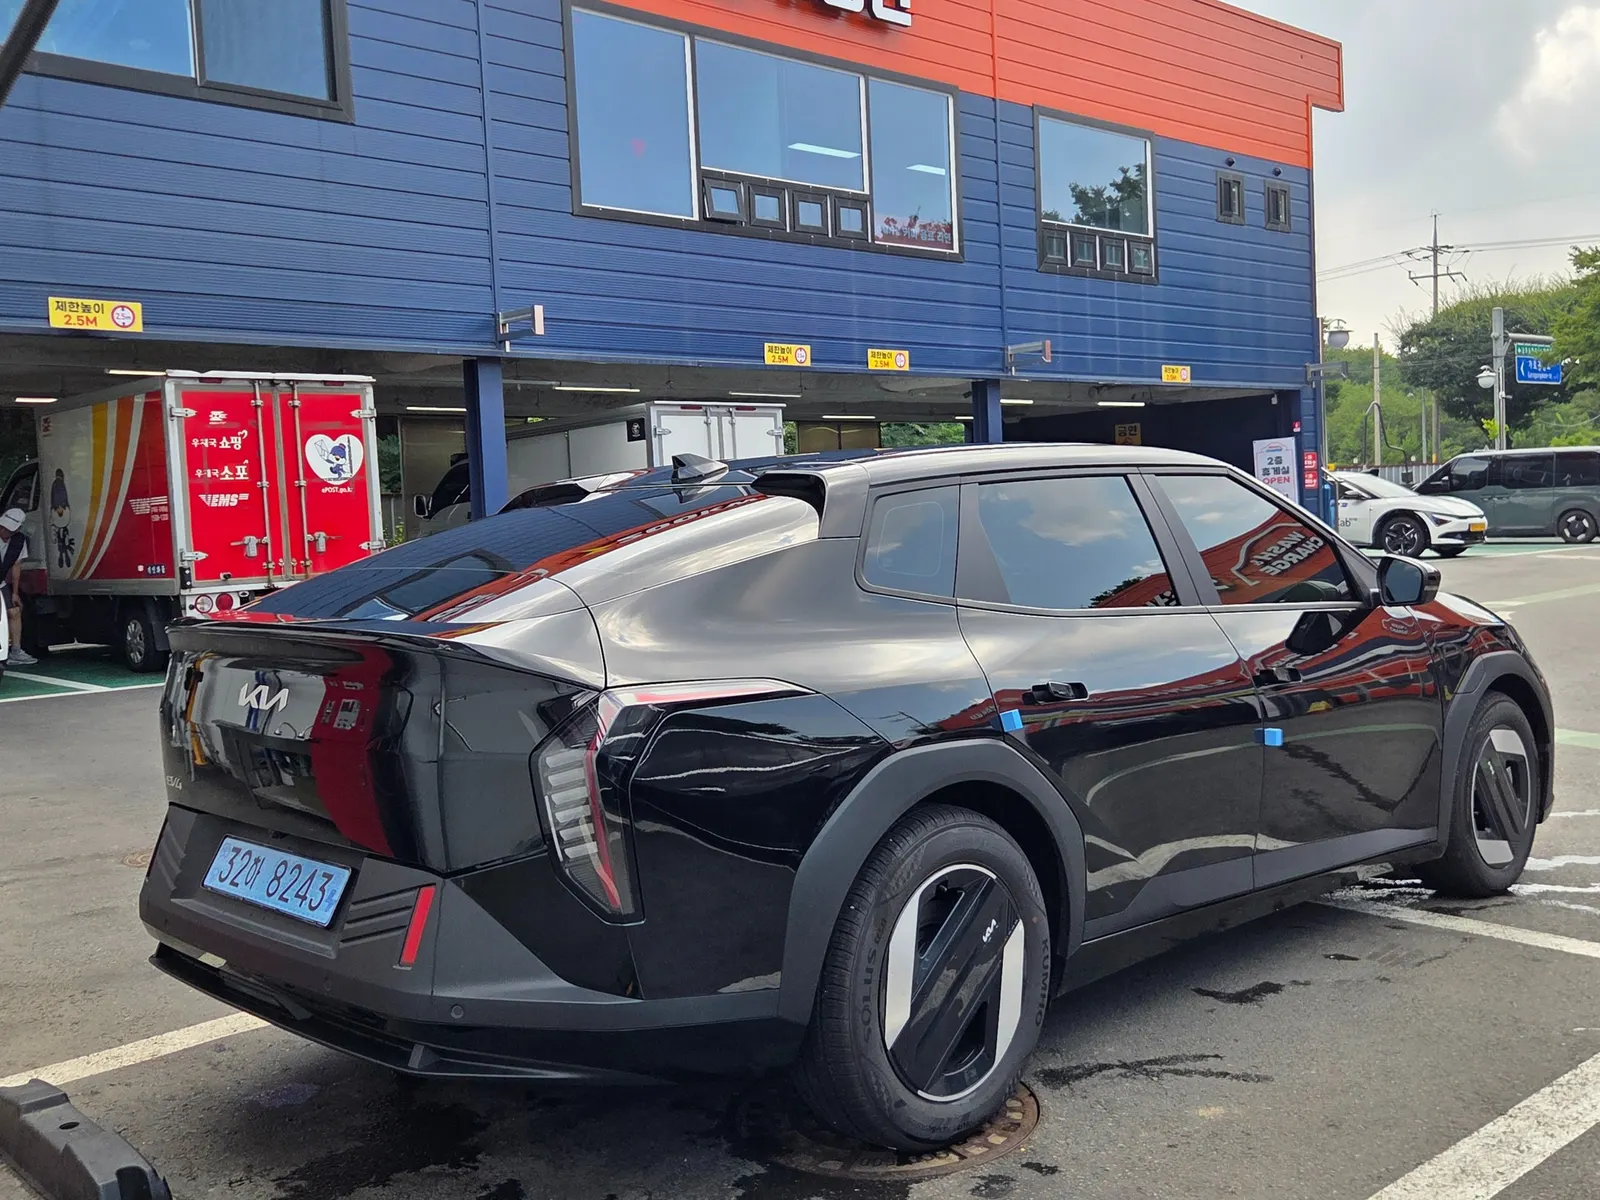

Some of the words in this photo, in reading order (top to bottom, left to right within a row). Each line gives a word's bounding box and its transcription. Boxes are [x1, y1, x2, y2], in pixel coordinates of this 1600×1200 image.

[55, 300, 104, 314] 제한높이
[63, 314, 98, 327] 2.5M
[771, 354, 789, 364] 2.5M
[874, 359, 890, 368] 2.5M
[219, 430, 248, 450] 쇼핑
[220, 465, 249, 481] 소포
[1261, 465, 1290, 477] 휴게실
[1262, 476, 1291, 485] OPEN
[210, 493, 239, 507] EMS
[218, 846, 265, 889] 32하
[266, 859, 334, 912] 8243
